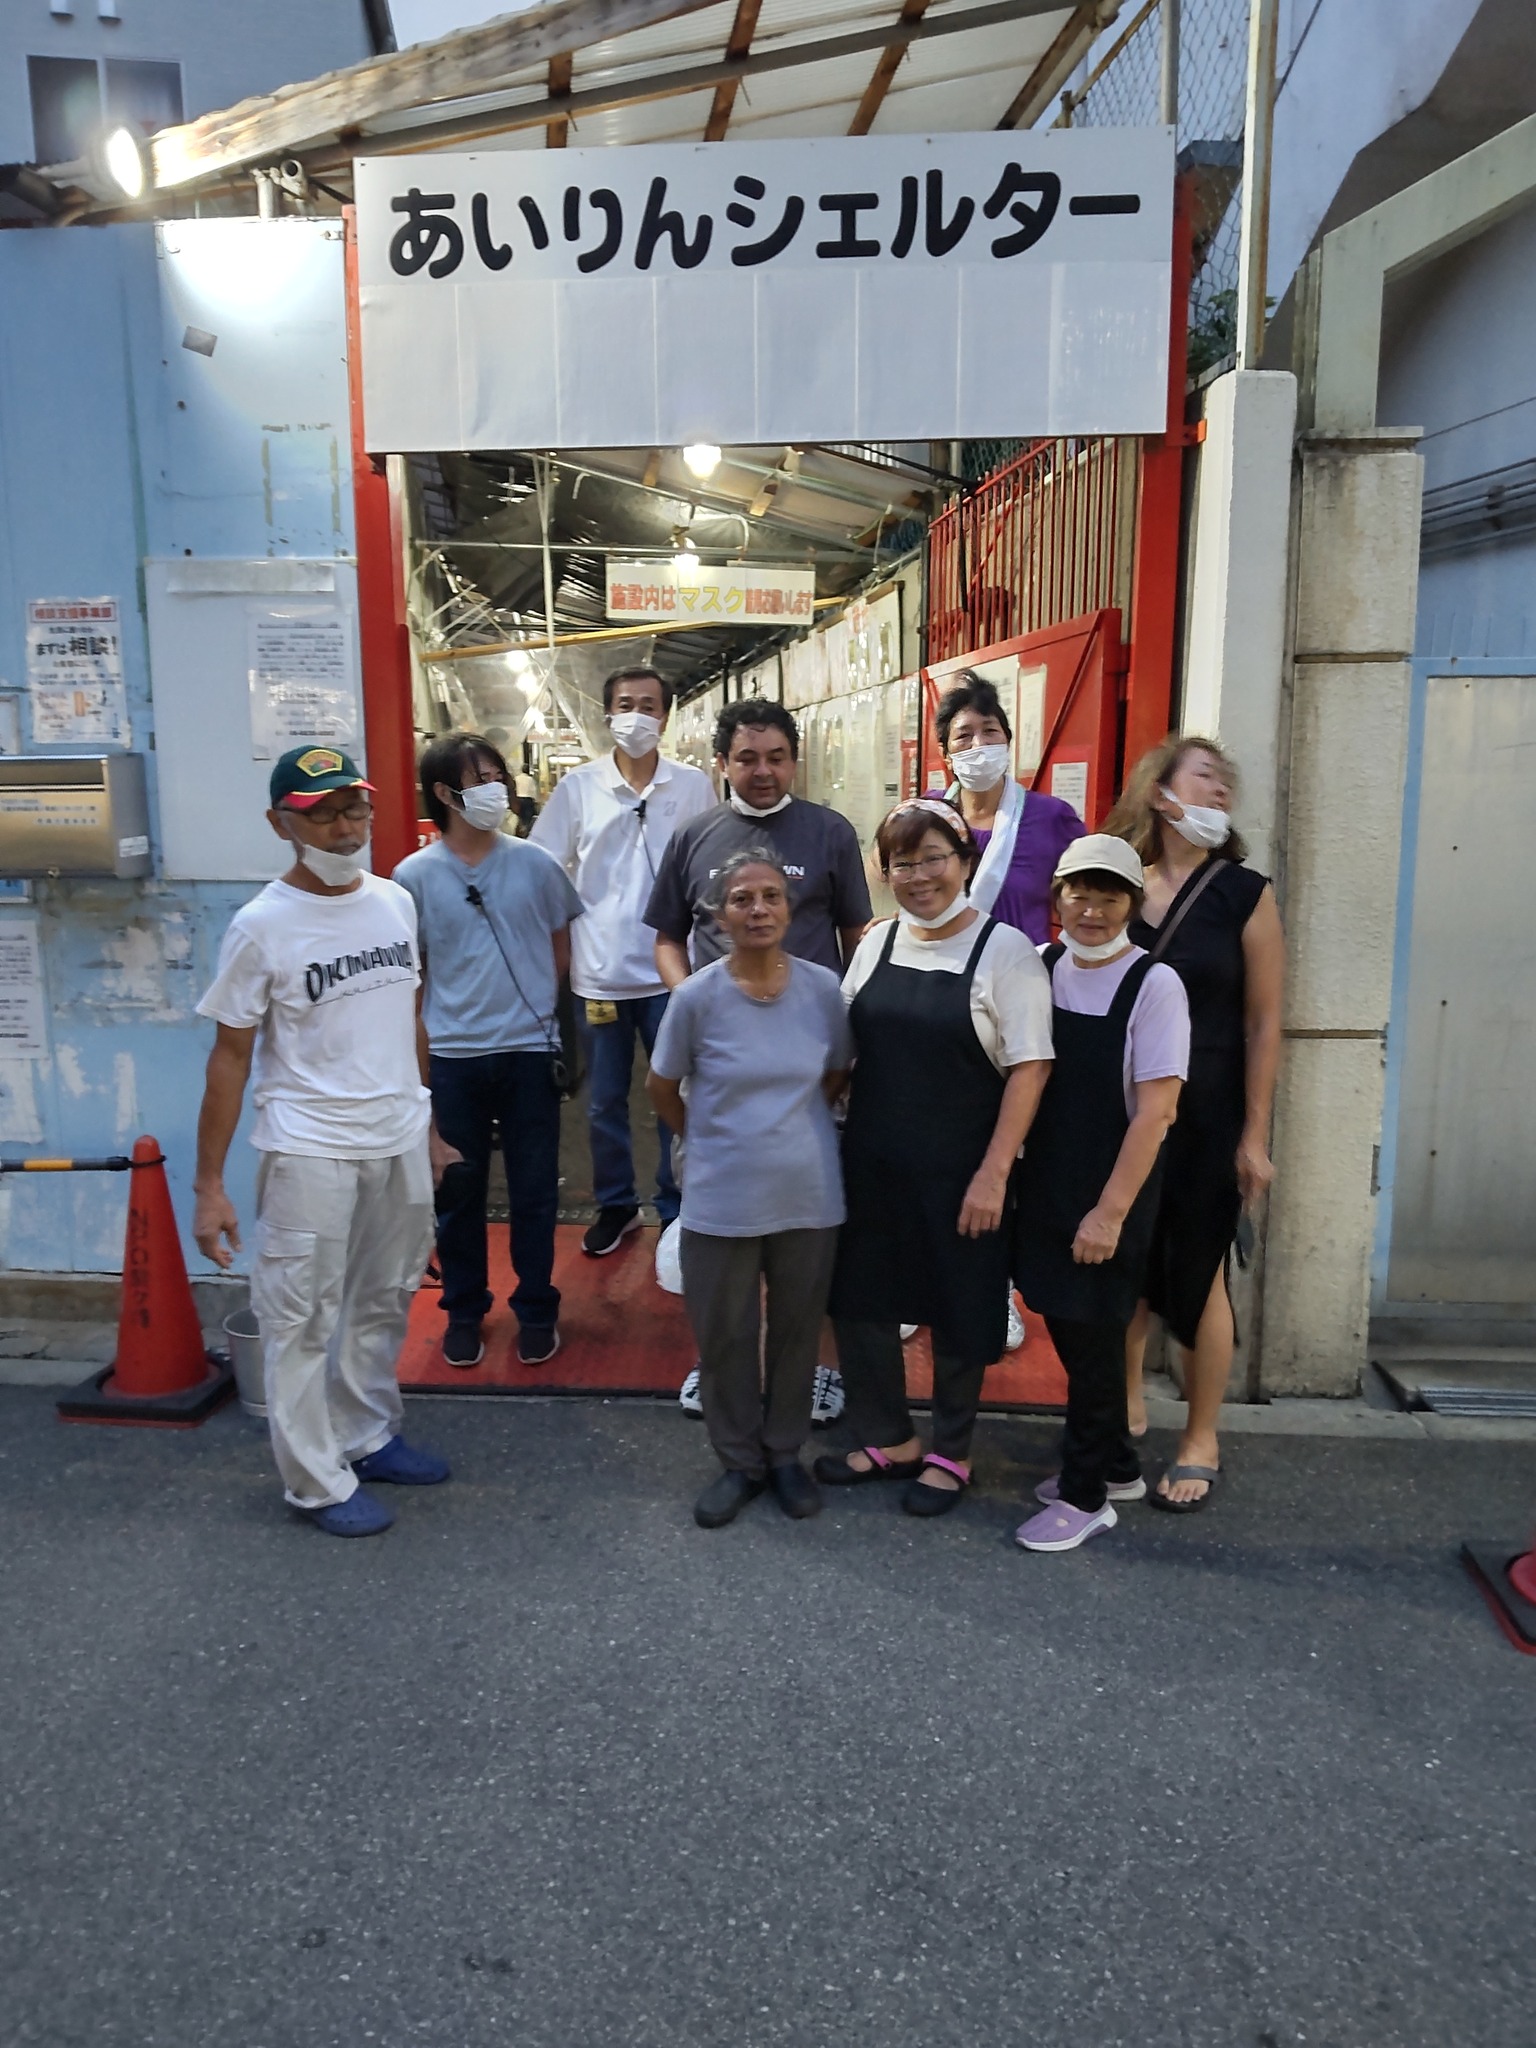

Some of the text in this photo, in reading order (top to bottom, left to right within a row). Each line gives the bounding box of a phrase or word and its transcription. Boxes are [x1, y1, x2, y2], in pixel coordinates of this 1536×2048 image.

[390, 162, 1140, 279] あいりんシェルター
